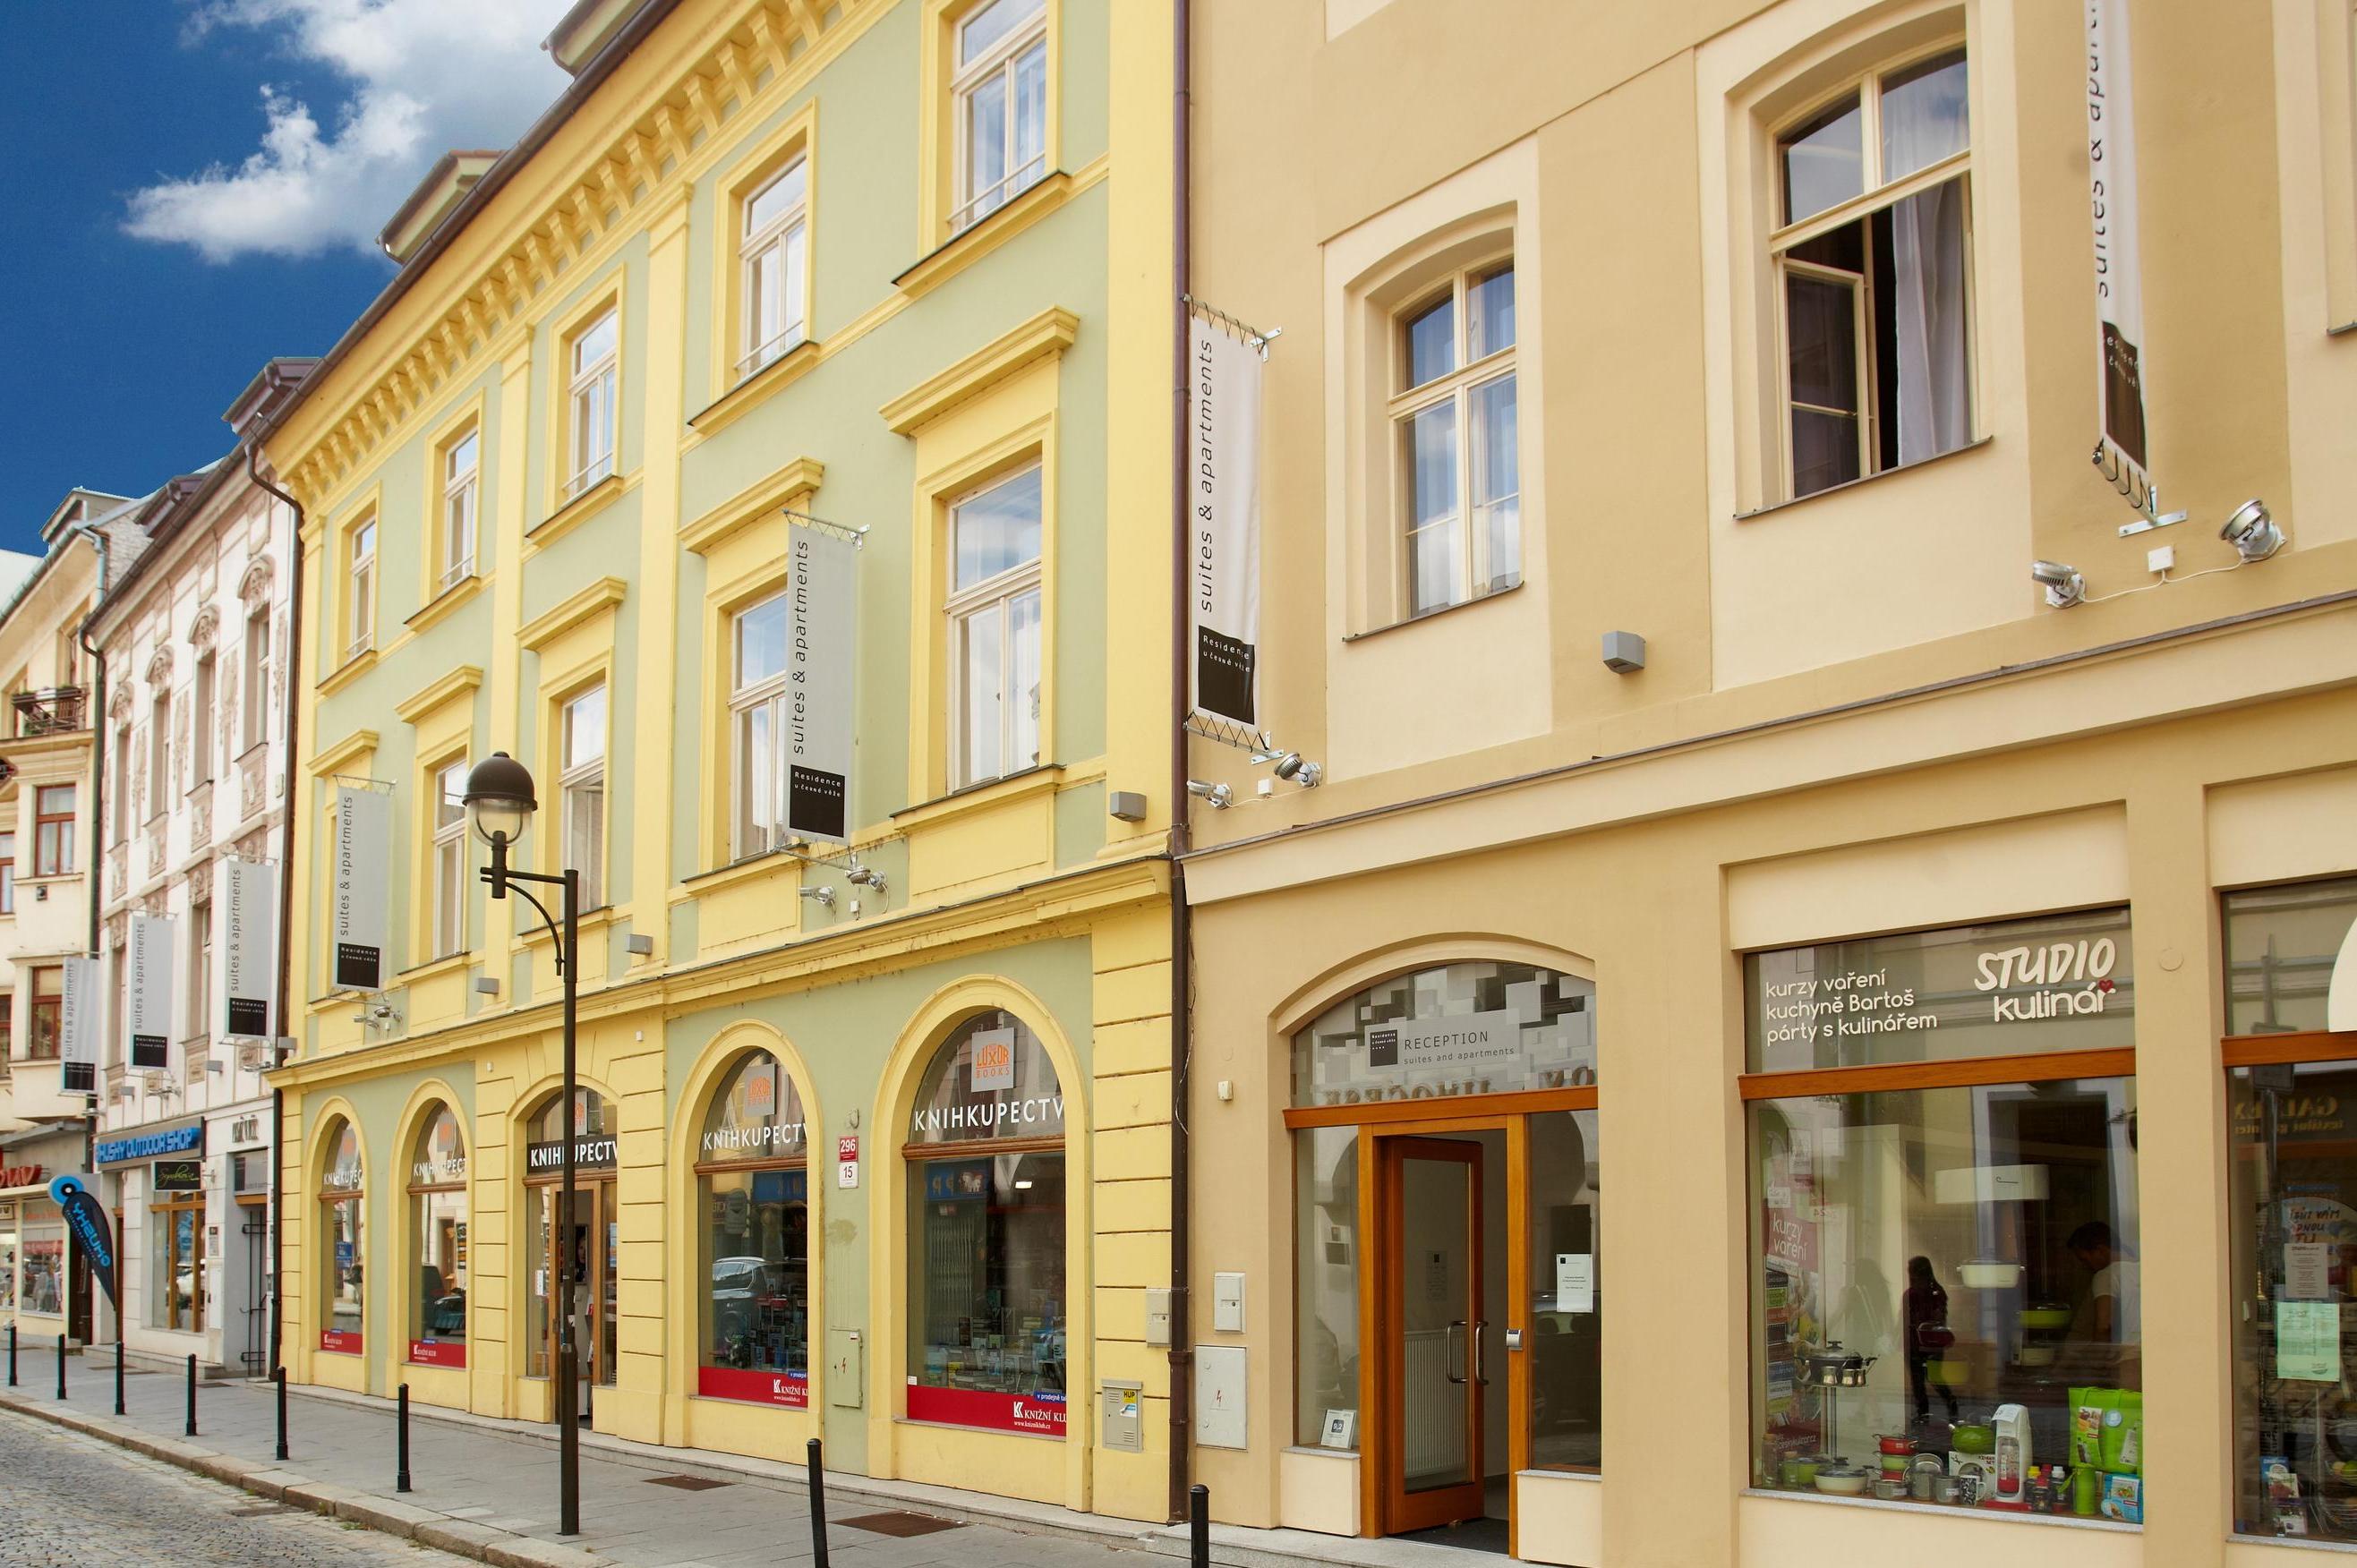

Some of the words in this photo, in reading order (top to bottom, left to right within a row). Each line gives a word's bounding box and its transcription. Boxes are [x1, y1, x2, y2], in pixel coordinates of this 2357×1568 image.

[1200, 338, 1218, 494] apartments
[1198, 504, 1213, 521] &
[1198, 532, 1213, 612] suites
[793, 540, 809, 662] apartments
[791, 670, 806, 684] &
[791, 690, 806, 755] suites
[794, 771, 841, 788] Residence
[342, 796, 353, 876] apartments
[339, 881, 350, 889] &
[232, 869, 242, 939] apartments
[340, 894, 350, 936] suites
[136, 923, 146, 984] apartments
[1974, 937, 2116, 992] STUDIO
[230, 955, 240, 992] suites
[1766, 980, 1818, 999] kurzy
[1823, 968, 1886, 992] vaření
[135, 998, 144, 1029] suites
[1766, 996, 1844, 1020] kuchyně
[1849, 988, 1915, 1012] Bartoš
[1405, 1030, 1489, 1051] RECEPTION
[1767, 1022, 1817, 1047] párty
[1823, 1024, 1834, 1037] s
[1838, 1012, 1938, 1036] kulinářem
[977, 1044, 1011, 1068] LUXOR
[1404, 1054, 1432, 1065] suites
[1436, 1052, 1454, 1062] and
[1457, 1046, 1515, 1061] apartments
[976, 1067, 1010, 1079] BOOKS
[531, 1140, 618, 1167] KNIHPECT
[840, 1139, 856, 1153] 296
[843, 1166, 853, 1179] 15
[1772, 1212, 1803, 1242] kurzy
[1773, 1237, 1807, 1261] vaření
[1041, 1393, 1060, 1402] prodejně
[1024, 1410, 1052, 1421] KNIŽNÍ
